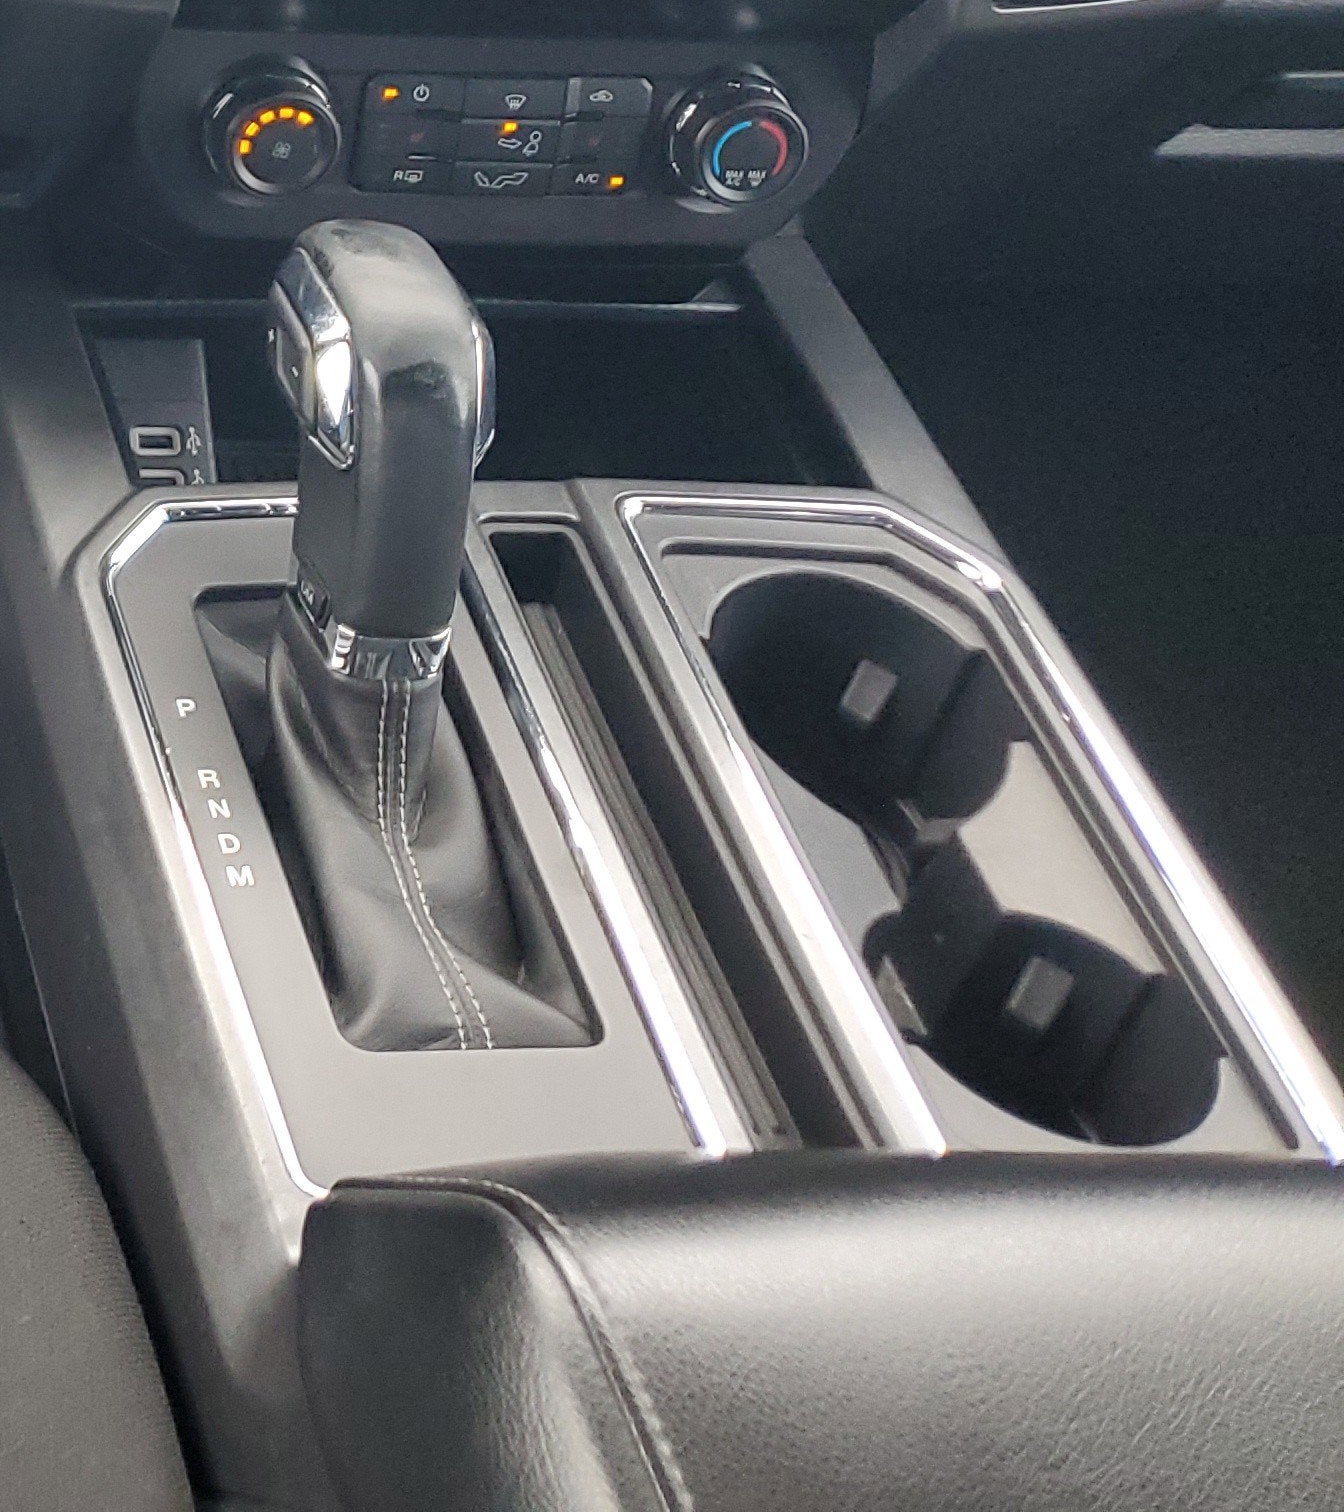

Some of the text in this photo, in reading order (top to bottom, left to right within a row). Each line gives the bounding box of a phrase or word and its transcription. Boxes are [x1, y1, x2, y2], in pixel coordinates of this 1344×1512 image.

[575, 173, 599, 184] A/C
[175, 698, 196, 718] P
[197, 769, 221, 789] R
[207, 798, 231, 819] N
[217, 833, 241, 855] D
[226, 865, 254, 886] M
